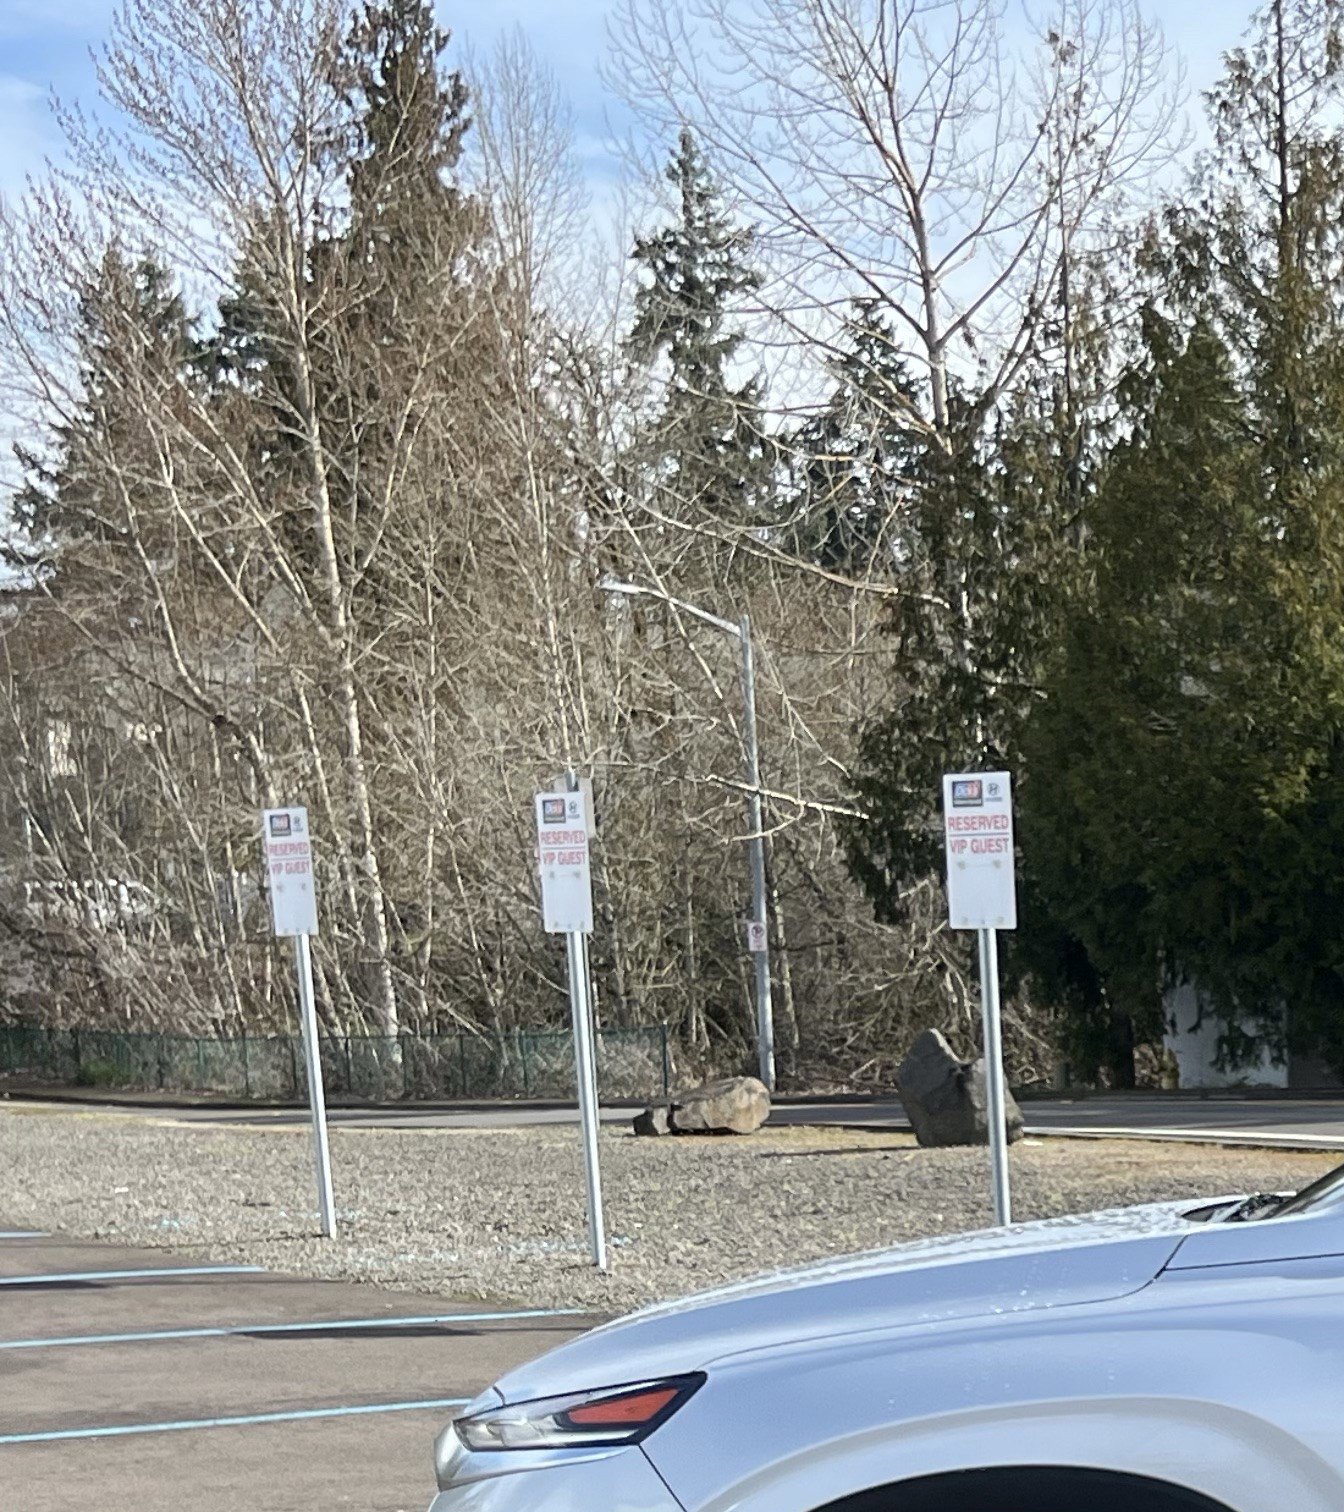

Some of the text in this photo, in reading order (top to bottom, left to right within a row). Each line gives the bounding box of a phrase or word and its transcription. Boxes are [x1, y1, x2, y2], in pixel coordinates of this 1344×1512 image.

[947, 814, 1009, 831] RESERVED
[949, 838, 1009, 854] VIP GUEST
